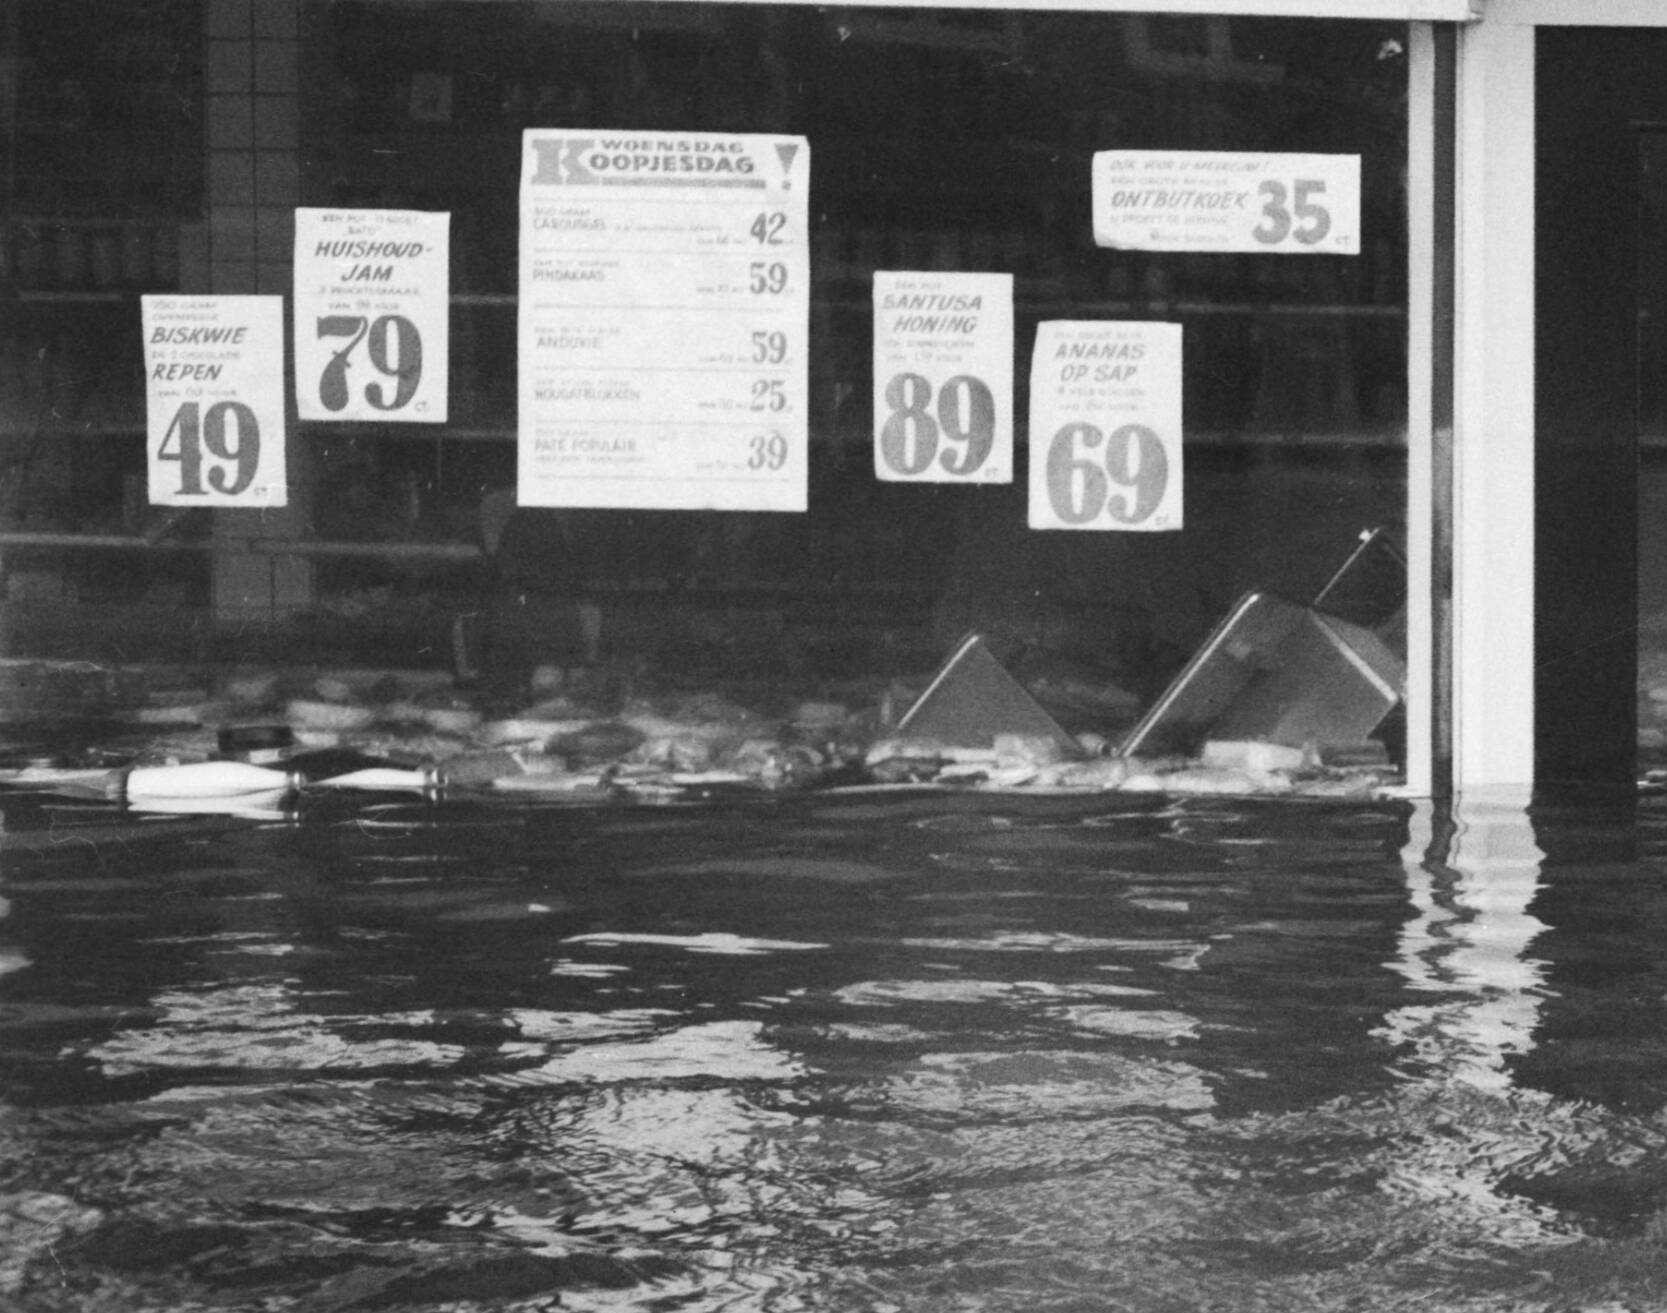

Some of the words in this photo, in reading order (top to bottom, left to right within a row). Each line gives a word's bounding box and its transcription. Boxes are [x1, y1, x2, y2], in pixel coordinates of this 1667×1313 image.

[600, 138, 745, 154] WOENSDAG
[749, 212, 787, 246] 42
[1252, 179, 1332, 246] 35
[315, 240, 433, 259] HUISHOUD-
[340, 264, 394, 283] JAM
[750, 261, 789, 295] 59
[882, 292, 983, 312] SANTUSA
[150, 325, 249, 345] BISKWIE
[892, 314, 978, 334] HONING
[316, 314, 424, 413] 79
[751, 331, 788, 365] 59
[1054, 342, 1147, 361] ANANAS
[152, 362, 224, 381] REPEN
[1060, 363, 1090, 383] OP
[1093, 363, 1139, 383] SAP
[749, 379, 788, 413] 25
[880, 372, 996, 476] 89
[156, 401, 261, 496] 49
[747, 434, 789, 471] 39
[1046, 421, 1169, 525] 69
